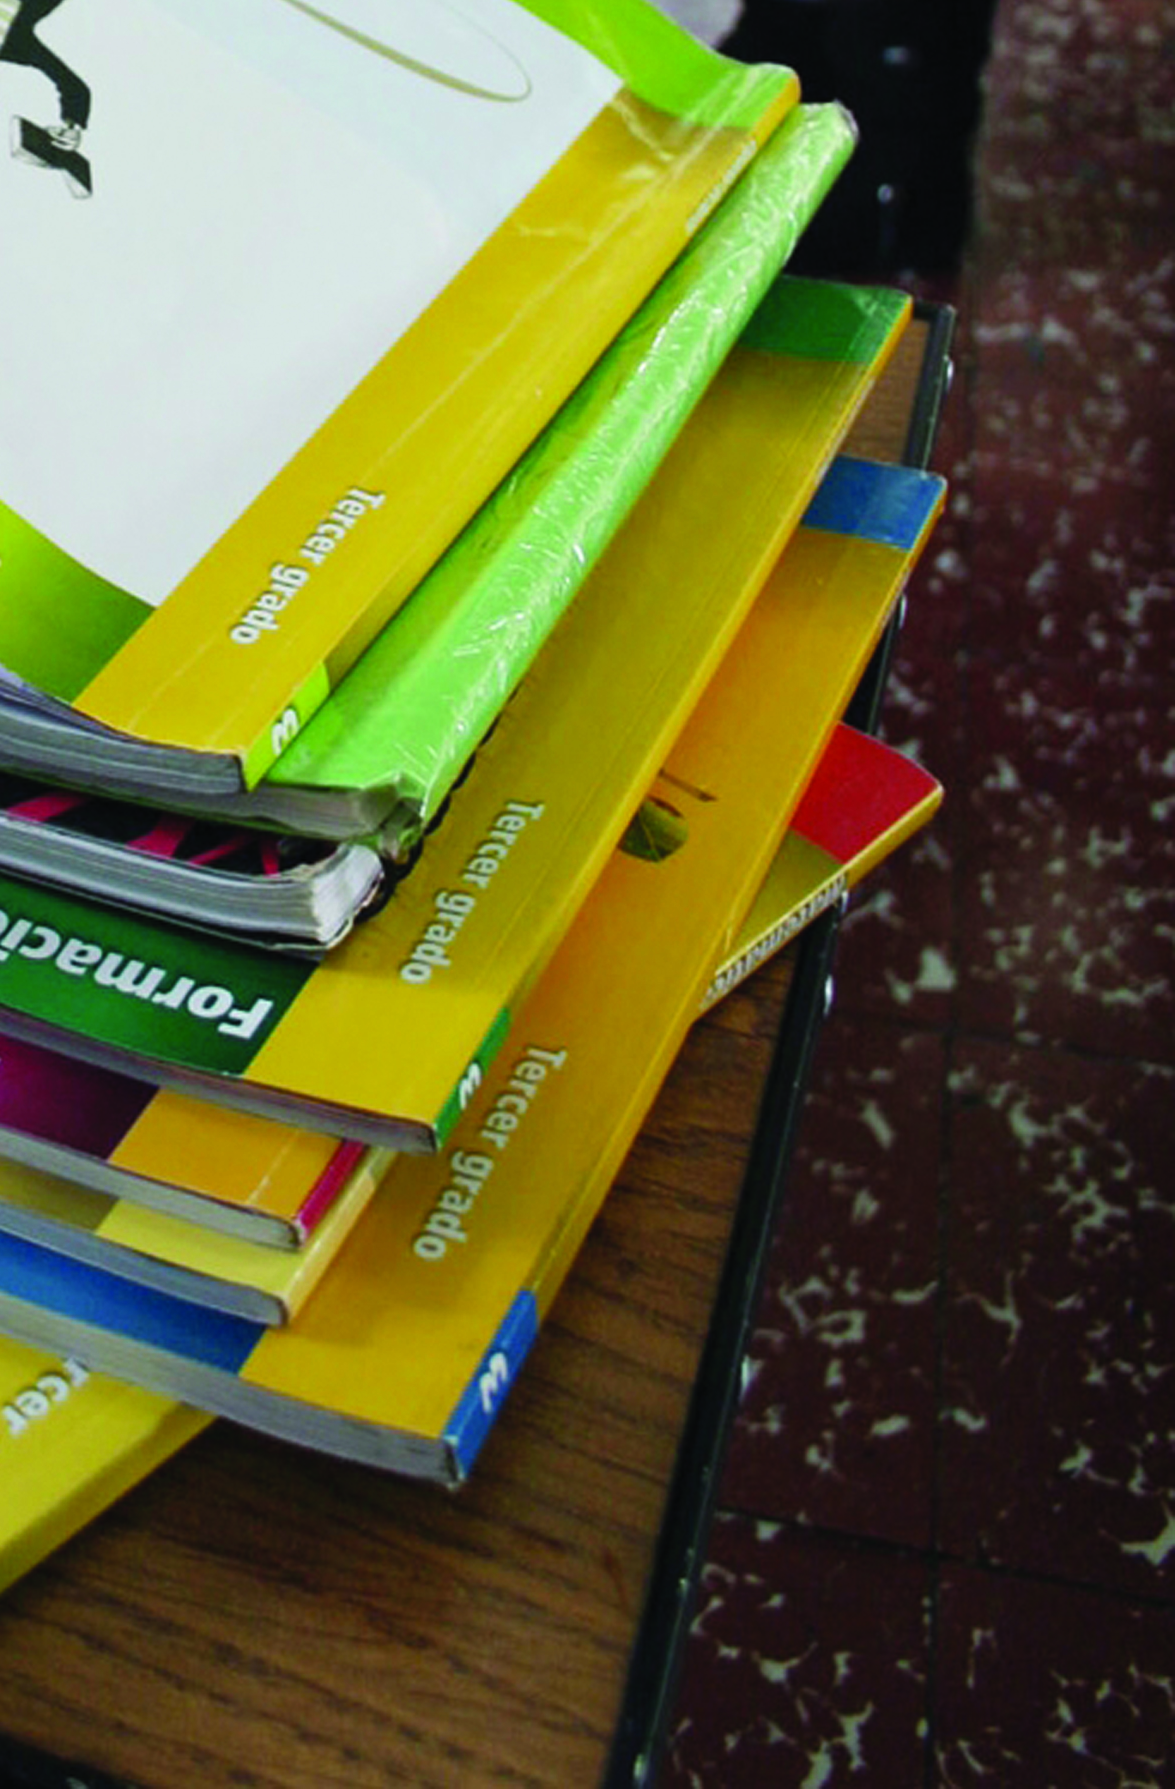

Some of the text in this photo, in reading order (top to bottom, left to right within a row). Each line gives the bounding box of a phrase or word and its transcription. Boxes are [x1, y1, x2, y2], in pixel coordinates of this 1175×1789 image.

[230, 485, 386, 644] Tercer grado
[400, 800, 546, 985] Tercer grado
[413, 1046, 568, 1260] Tercer grado
[1, 1357, 90, 1436] rcer
